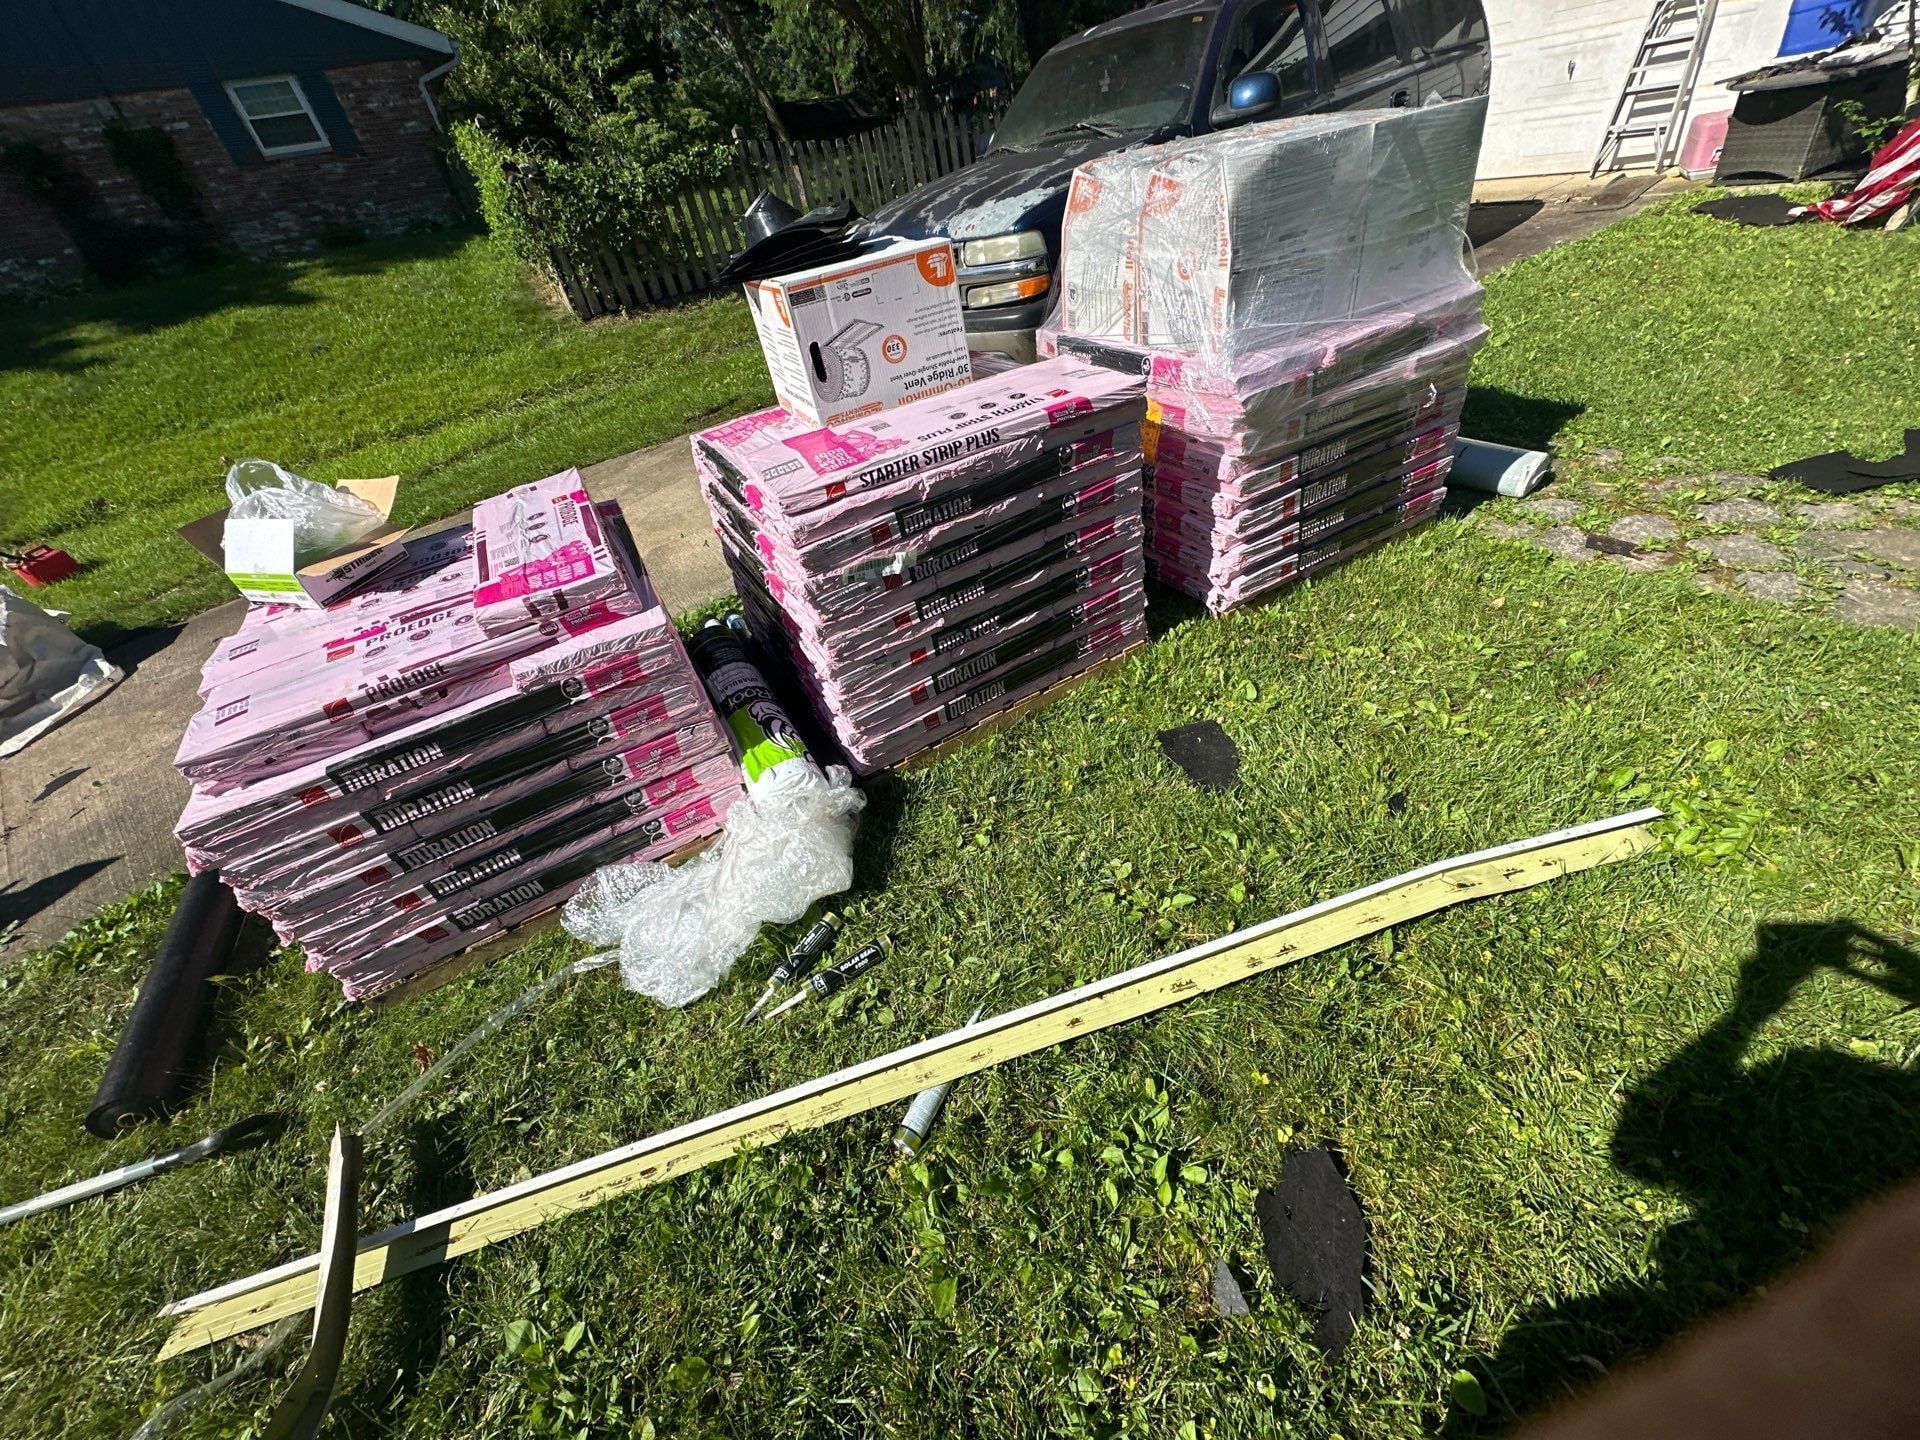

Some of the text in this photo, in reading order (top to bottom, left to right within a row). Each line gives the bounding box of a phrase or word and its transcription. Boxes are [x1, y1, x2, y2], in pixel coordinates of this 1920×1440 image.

[886, 342, 900, 353] 330
[938, 326, 963, 337] Features:
[889, 354, 968, 383] Low-Profile Shingle-Over Vent
[904, 376, 927, 391] Vent
[927, 368, 954, 381] Ridge
[917, 427, 953, 442] PLUS
[955, 414, 994, 431] STRIP
[860, 427, 1000, 488] STARTER STRIP PLUS
[1301, 439, 1348, 473] DURATION
[1302, 473, 1349, 507] DURATION
[903, 494, 972, 533] DURATION
[342, 548, 384, 573] STINGER
[914, 541, 979, 580] DURATION
[365, 609, 457, 648] PROEDGE
[939, 615, 1000, 655] DURATION
[364, 661, 450, 704] PROEDGE
[938, 652, 997, 691] DURATION
[949, 681, 1006, 719] DURATION
[341, 741, 444, 792] DURATION
[374, 780, 476, 831] DURATION
[402, 819, 498, 871] DURATION
[432, 848, 523, 895] DURATION
[456, 880, 545, 926] DURATION
[840, 947, 877, 972] SOLAR SEAL
